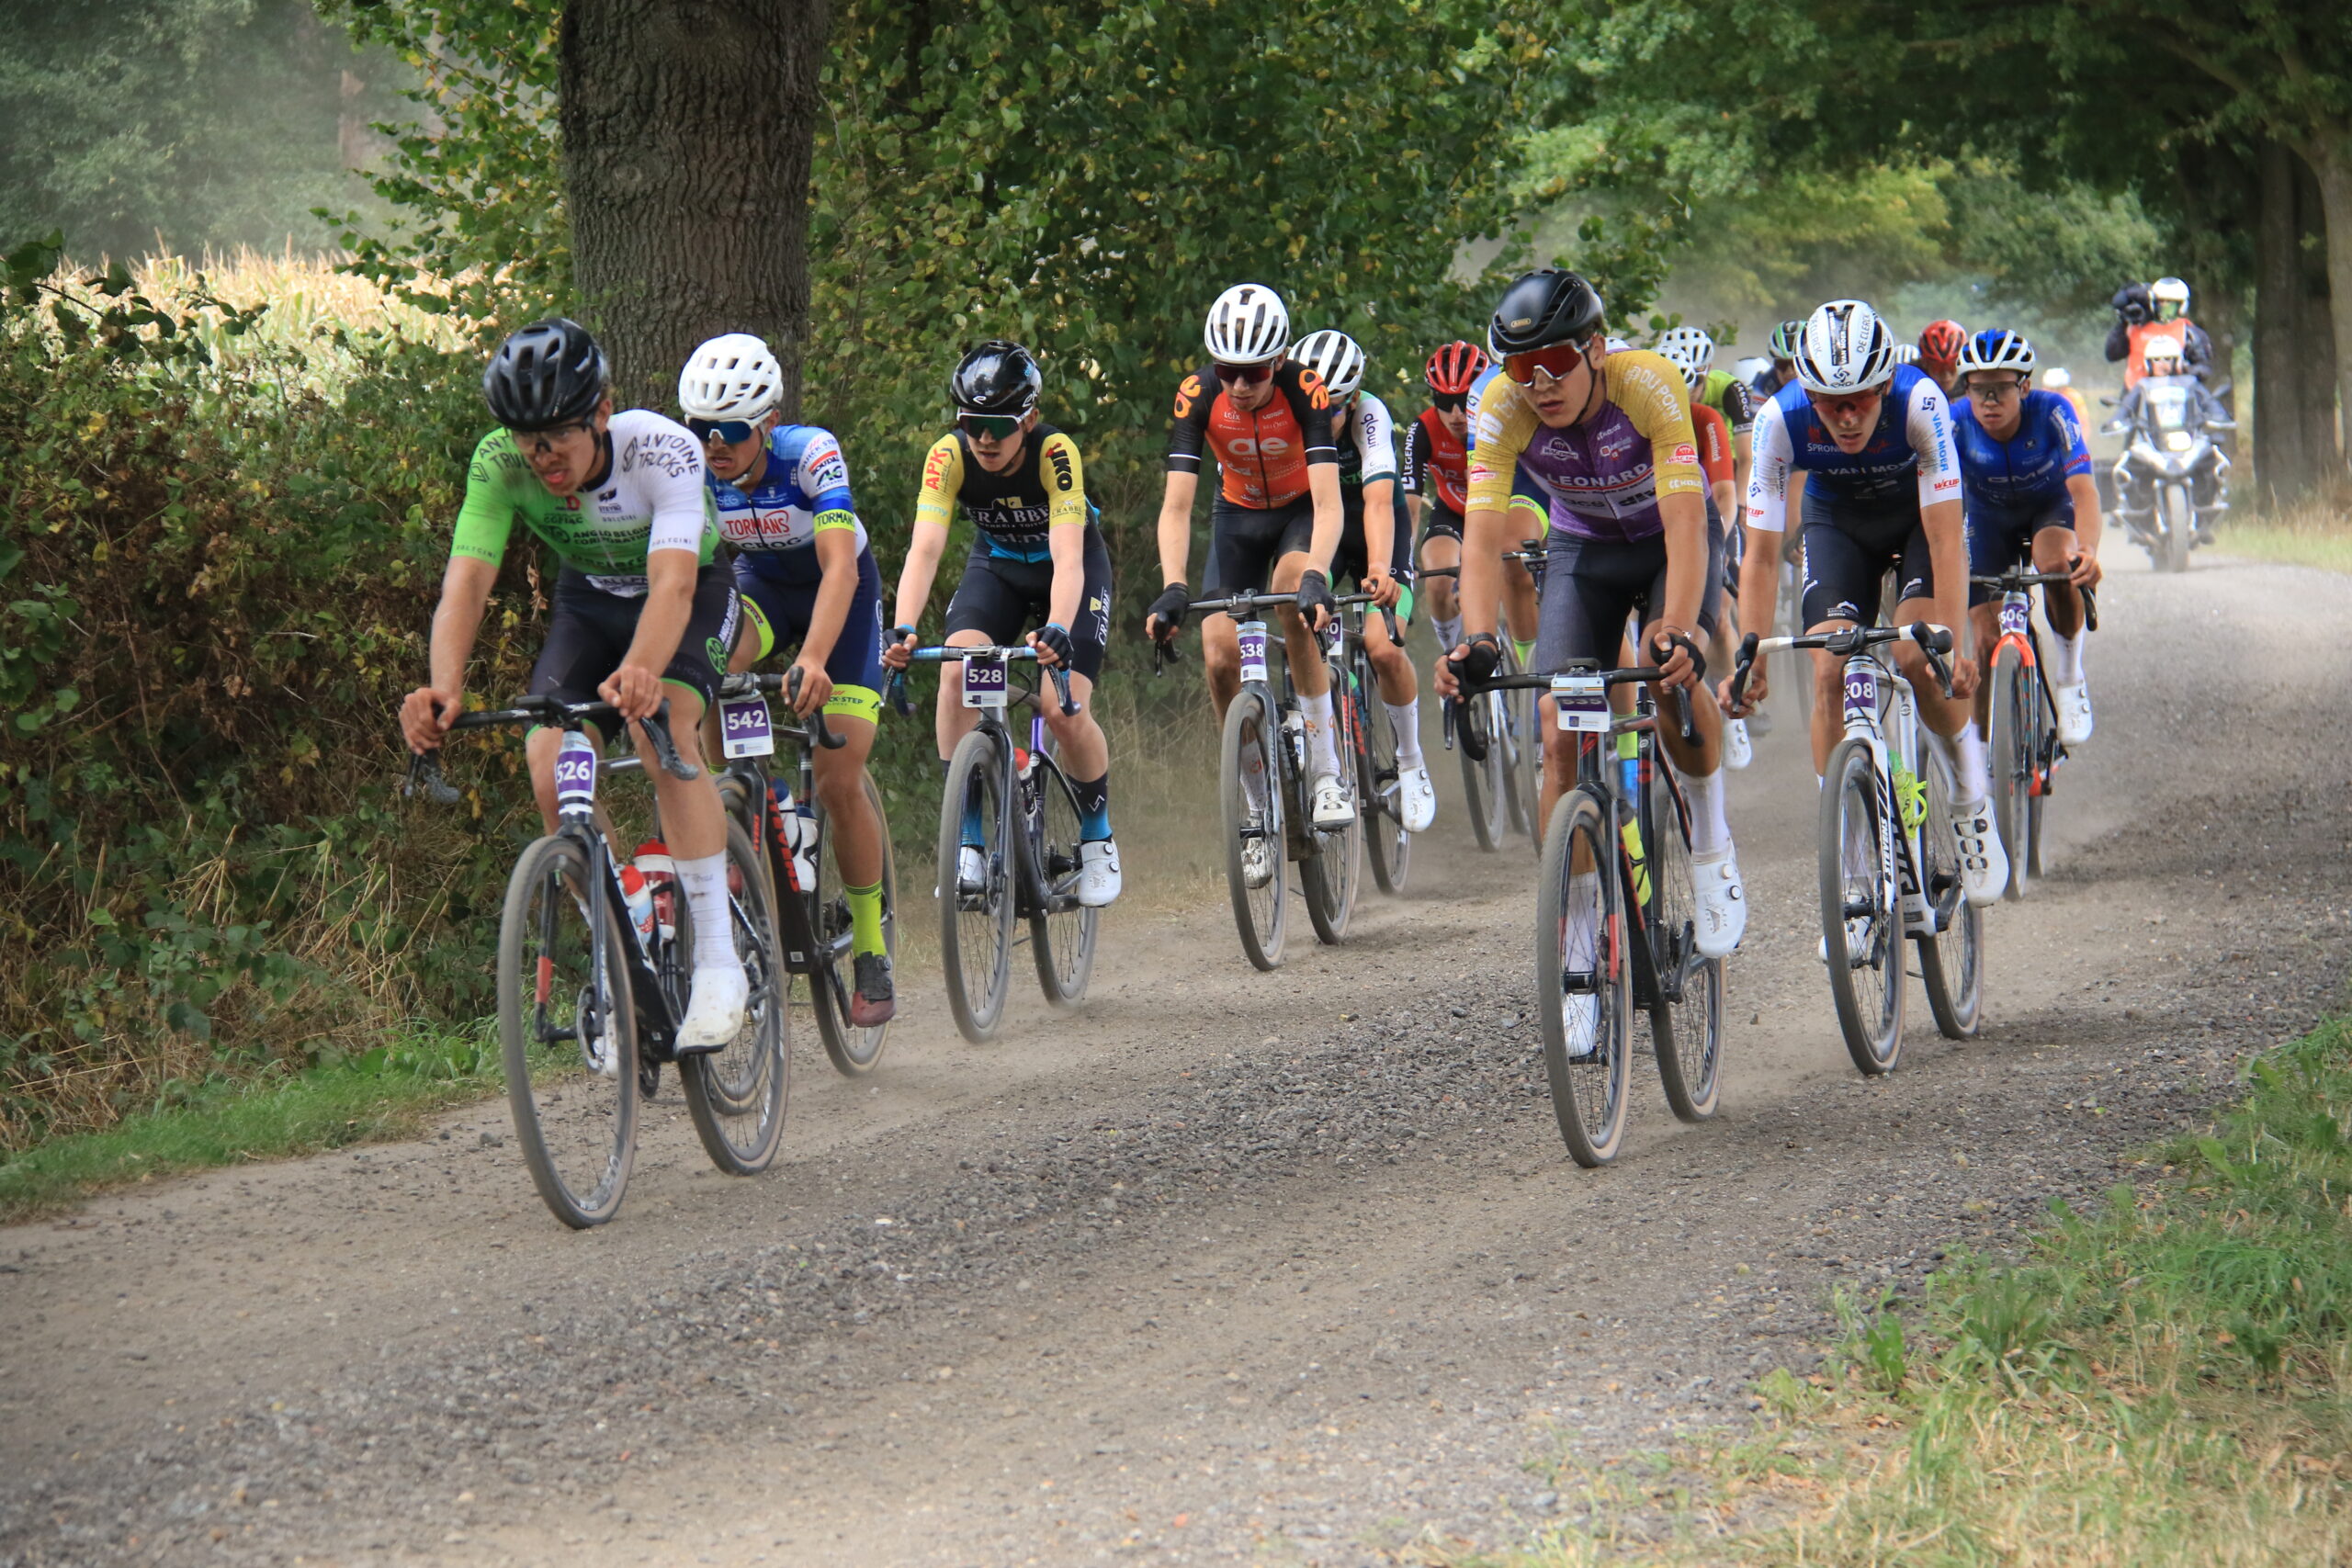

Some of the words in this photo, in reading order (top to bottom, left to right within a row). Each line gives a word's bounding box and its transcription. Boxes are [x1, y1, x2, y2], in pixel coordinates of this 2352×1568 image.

[1655, 381, 1684, 423] PONT
[1752, 413, 1767, 453] MOER
[1932, 412, 1944, 439] VAN
[1938, 439, 1950, 473] MOER
[642, 434, 700, 475] ANTOINE
[1227, 437, 1288, 456] ae
[1404, 421, 1419, 477] LEGENDRE
[639, 452, 685, 478] TRUCKS
[925, 447, 948, 491] APK
[1546, 463, 1649, 487] LEONARD
[1747, 507, 1765, 517] CUP
[573, 530, 613, 539] ANGLO
[614, 524, 652, 536] BELGIA
[724, 517, 790, 536] TORMANS
[573, 532, 652, 546] CORPORATIO
[2000, 608, 2025, 625] 506
[1240, 643, 1264, 659] 538
[967, 668, 1003, 683] 528
[727, 709, 767, 730] 542
[557, 760, 592, 784] 526
[1881, 818, 1892, 876] STEVENS
